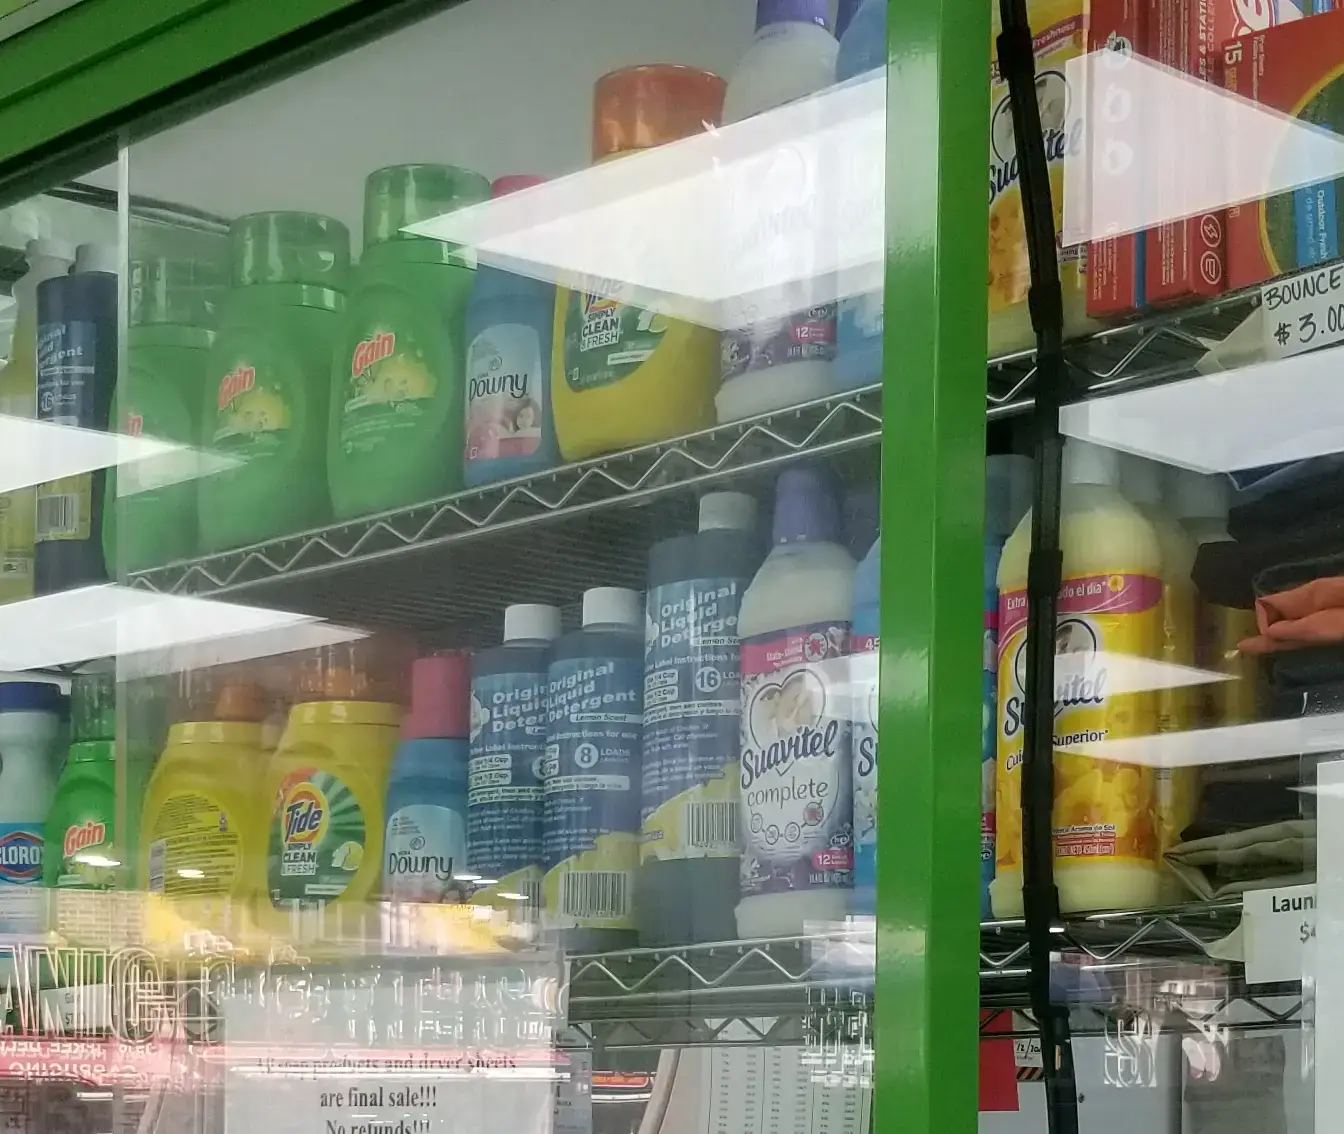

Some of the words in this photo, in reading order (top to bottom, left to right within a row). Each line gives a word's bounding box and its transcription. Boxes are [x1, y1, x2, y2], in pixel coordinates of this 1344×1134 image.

[1224, 41, 1242, 65] 15
[1264, 266, 1343, 310] BOUNCE
[582, 318, 619, 338] CLEAN
[588, 308, 615, 321] SIMPLY
[587, 332, 618, 348] FRESH
[795, 326, 808, 339] 12
[1274, 322, 1292, 345] $
[352, 331, 395, 377] Gain
[217, 366, 255, 412] Gain
[468, 371, 529, 400] Downy
[661, 583, 736, 617] Original
[661, 603, 716, 632] Liquid
[550, 661, 614, 693] Original
[697, 671, 718, 688] 16
[549, 680, 595, 708] Liquid
[549, 689, 636, 722] Detergent
[580, 746, 591, 764] 8
[741, 719, 838, 790] Suavitel
[747, 775, 829, 810] complete
[284, 802, 323, 843] Tide
[64, 822, 105, 856] Gain
[283, 851, 316, 863] CLEAN
[287, 863, 316, 875] FRESH
[389, 853, 453, 881] Downy
[818, 853, 831, 865] 12
[320, 1091, 343, 1107] are
[347, 1087, 384, 1107] final
[388, 1086, 437, 1107] sale!!!
